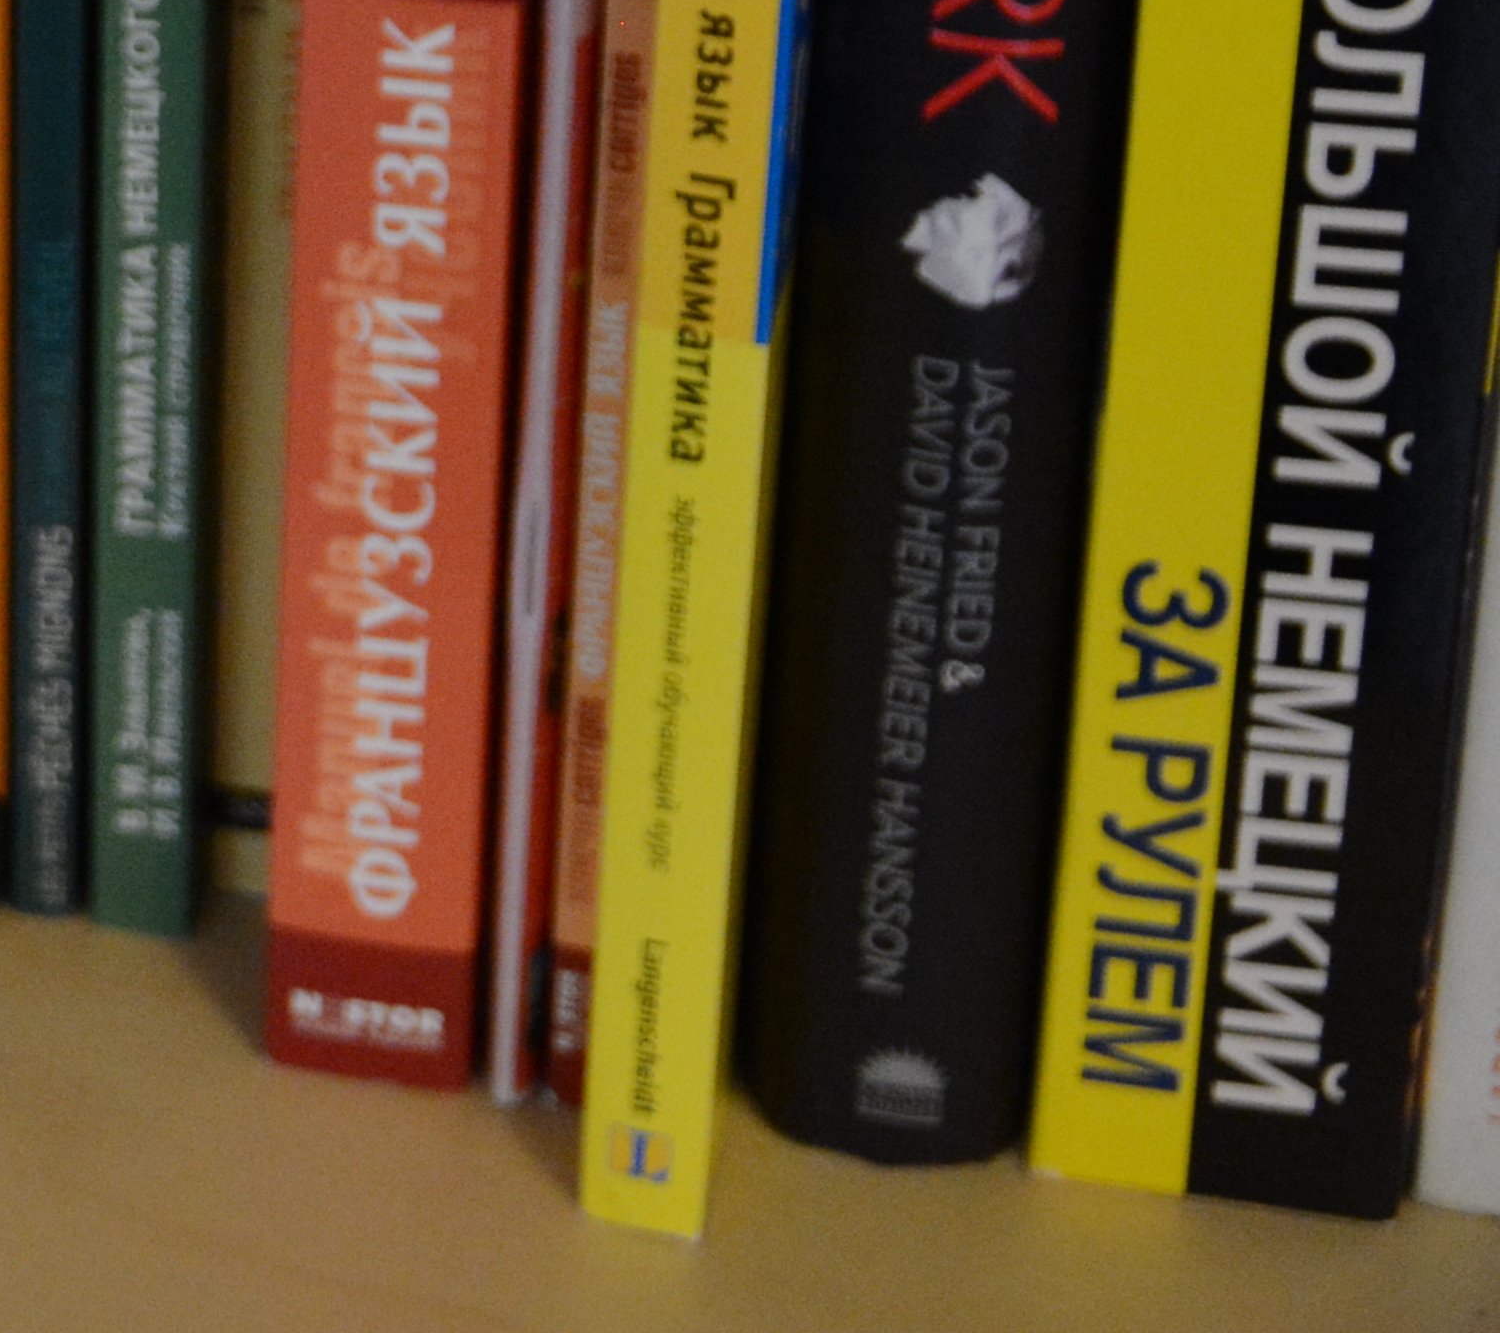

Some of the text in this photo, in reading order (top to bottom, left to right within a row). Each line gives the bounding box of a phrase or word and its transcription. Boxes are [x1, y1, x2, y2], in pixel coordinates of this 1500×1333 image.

[371, 18, 459, 257] ЯЗЫК
[686, 5, 740, 143] язык
[113, 245, 157, 539] ГРАММАТИКА
[667, 169, 740, 464] Грамматика
[346, 298, 445, 920] ФРАНЦУЗСКИЙ
[857, 354, 959, 995] DAVID HEINEMEIER HANSSON
[938, 360, 1015, 694] JASON FRIED &
[1078, 558, 1233, 1094] ЗА РУЛЕМ
[1209, 520, 1376, 1116] НЕМЕЦКИЙ
[631, 937, 672, 1116] Langenscheidt
